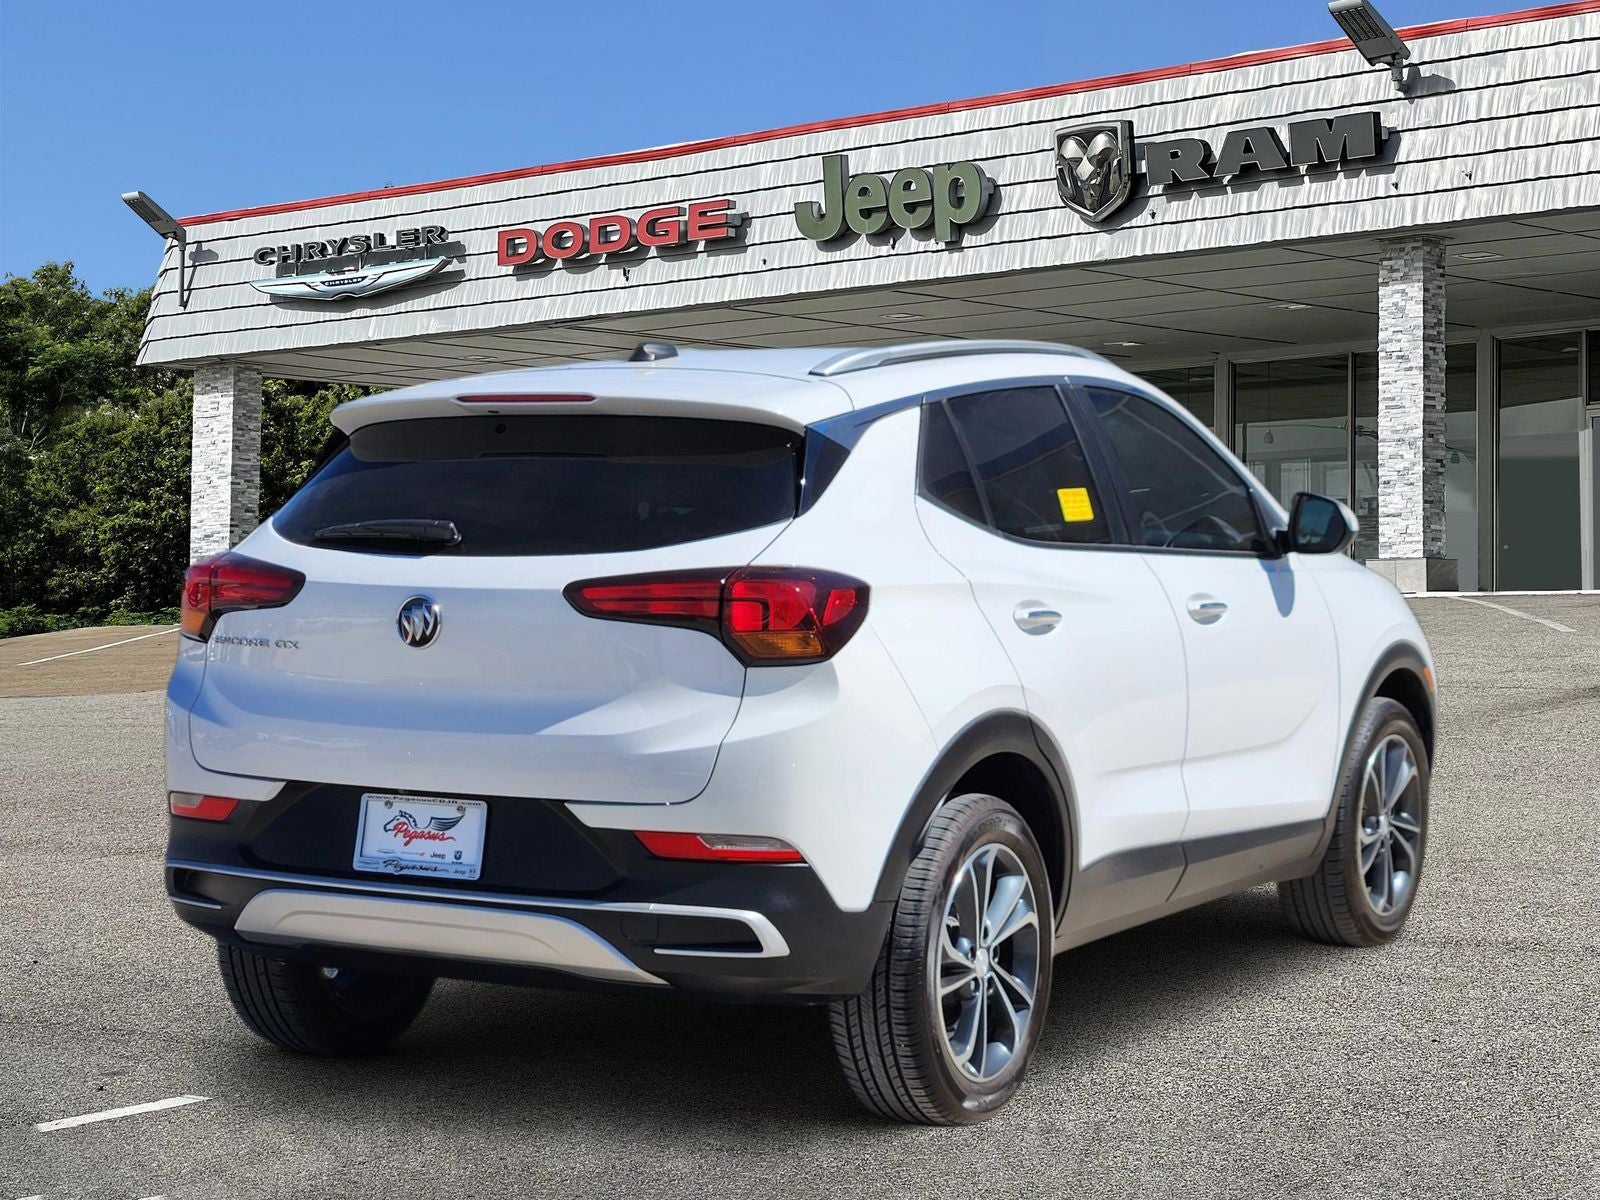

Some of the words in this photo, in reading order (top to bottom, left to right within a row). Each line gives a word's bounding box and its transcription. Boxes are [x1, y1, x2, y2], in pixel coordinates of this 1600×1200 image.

[1145, 111, 1381, 187] RAM
[794, 154, 988, 243] Jeep
[253, 225, 448, 266] CHRYSLER
[497, 198, 736, 267] DODGE
[324, 276, 364, 287] CHRYSLER
[215, 635, 271, 648] ENCORE
[393, 821, 456, 847] Pegasus
[430, 851, 447, 860] Jeep
